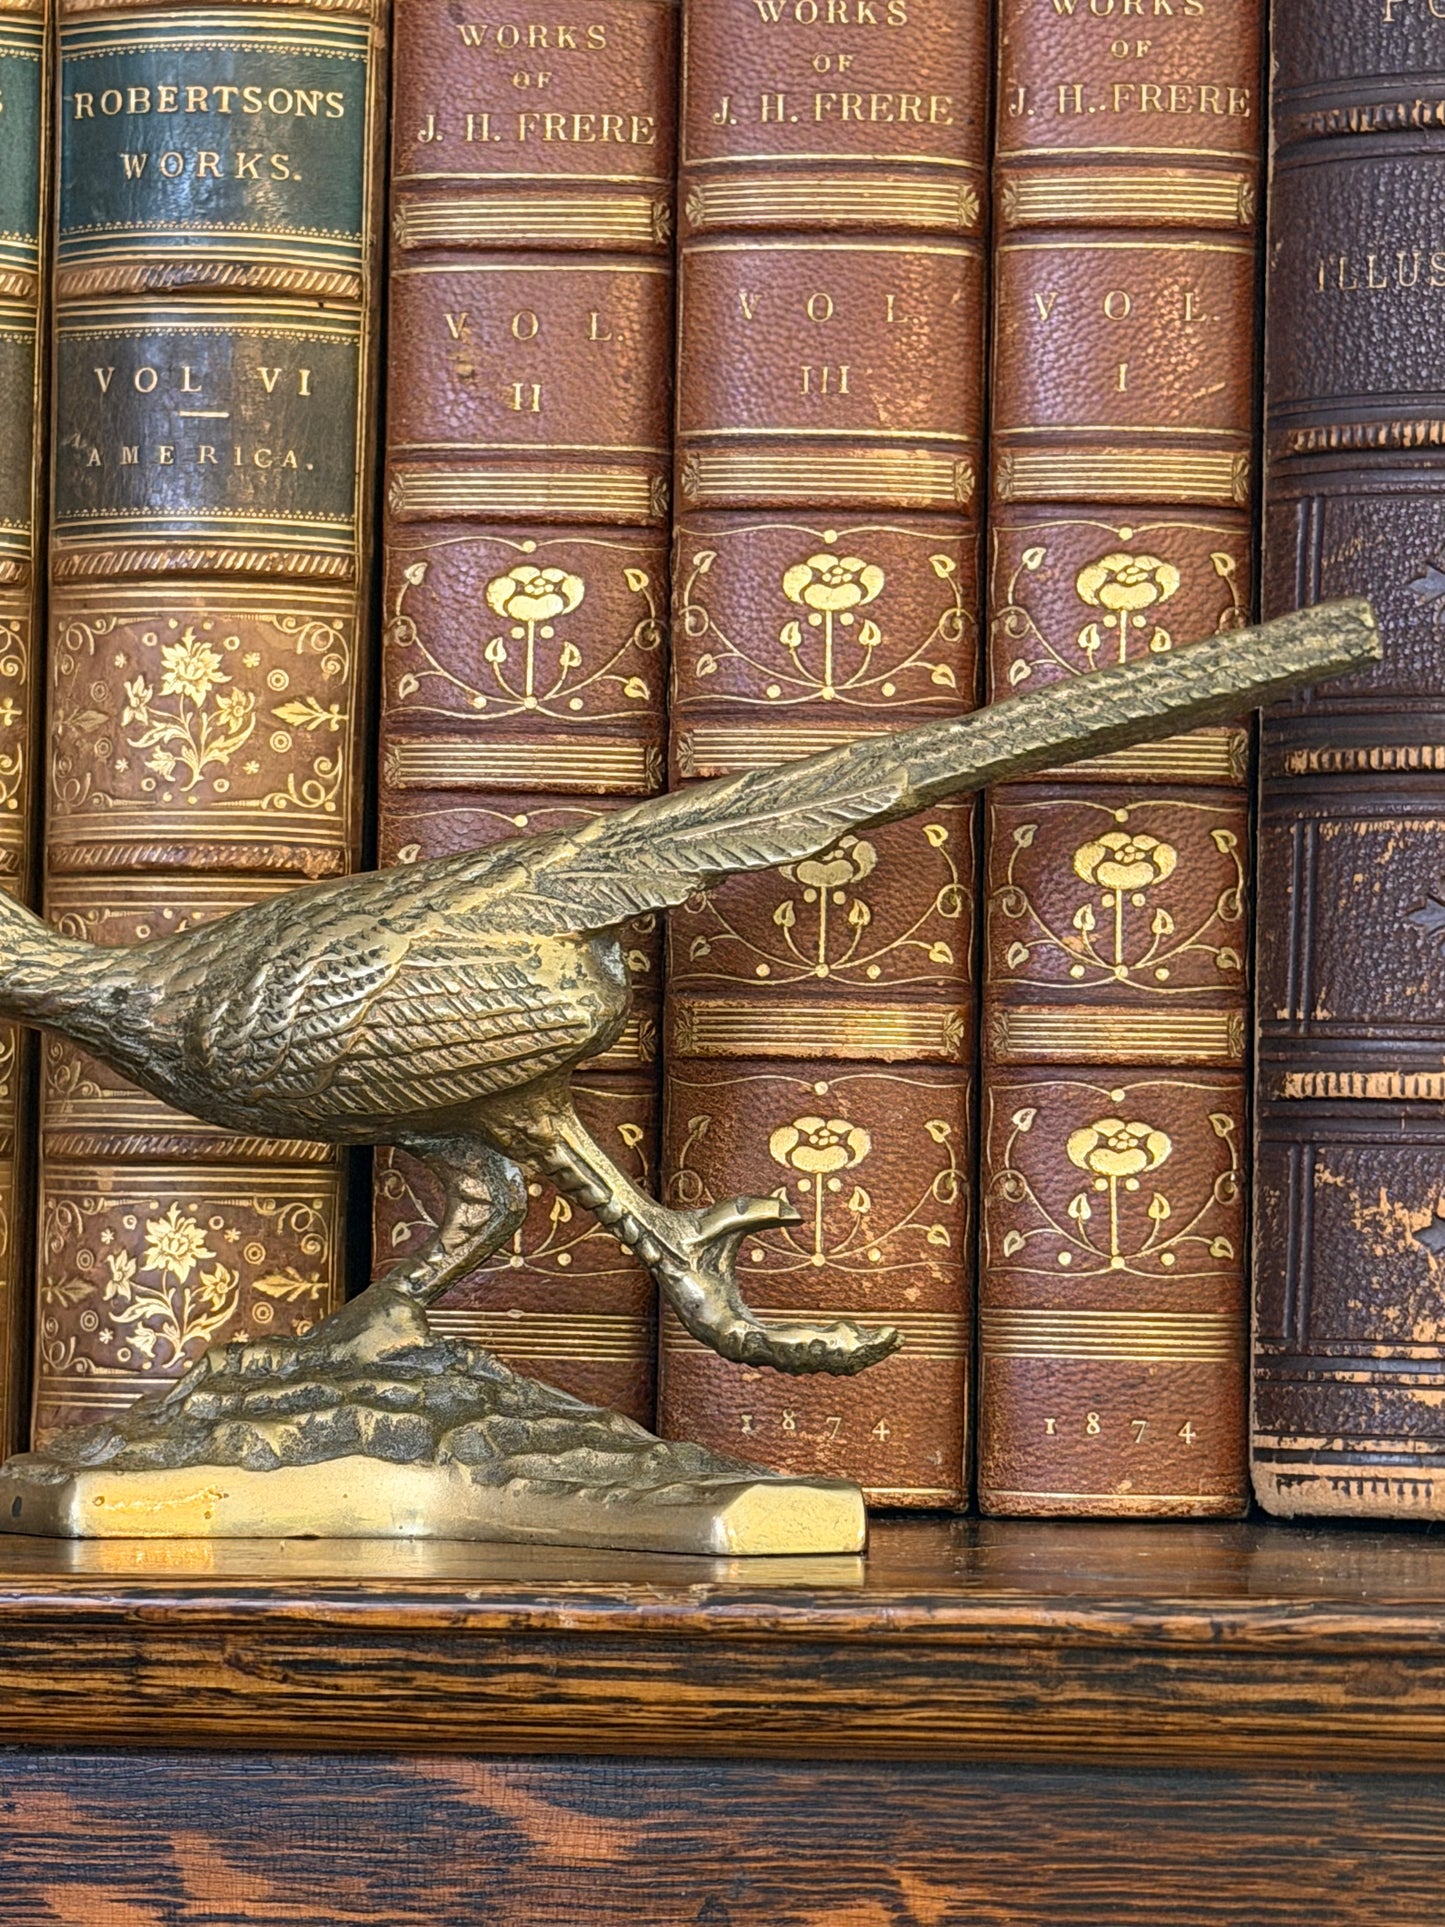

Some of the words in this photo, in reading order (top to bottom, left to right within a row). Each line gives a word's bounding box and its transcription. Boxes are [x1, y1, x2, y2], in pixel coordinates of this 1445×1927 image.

[751, 0, 909, 27] WORKS
[1053, 0, 1205, 16] WORKS
[456, 23, 608, 50] WORKS
[1110, 39, 1153, 59] OF
[812, 52, 854, 73] OF
[512, 70, 553, 90] OF
[73, 85, 346, 120] ROBERTSON'S
[712, 96, 738, 125] J.
[761, 94, 799, 123] H.
[814, 92, 955, 125] FRERE
[1008, 87, 1035, 118] J.
[1112, 83, 1251, 118] FRERE
[417, 113, 444, 142] J.
[465, 112, 502, 142] H.
[518, 112, 657, 145] FRERE
[119, 151, 302, 181] WORKS.
[93, 366, 202, 394] VOL
[256, 367, 312, 397] VI
[800, 365, 851, 394] III
[511, 382, 543, 412] II
[1043, 1411, 1197, 1445] 1874
